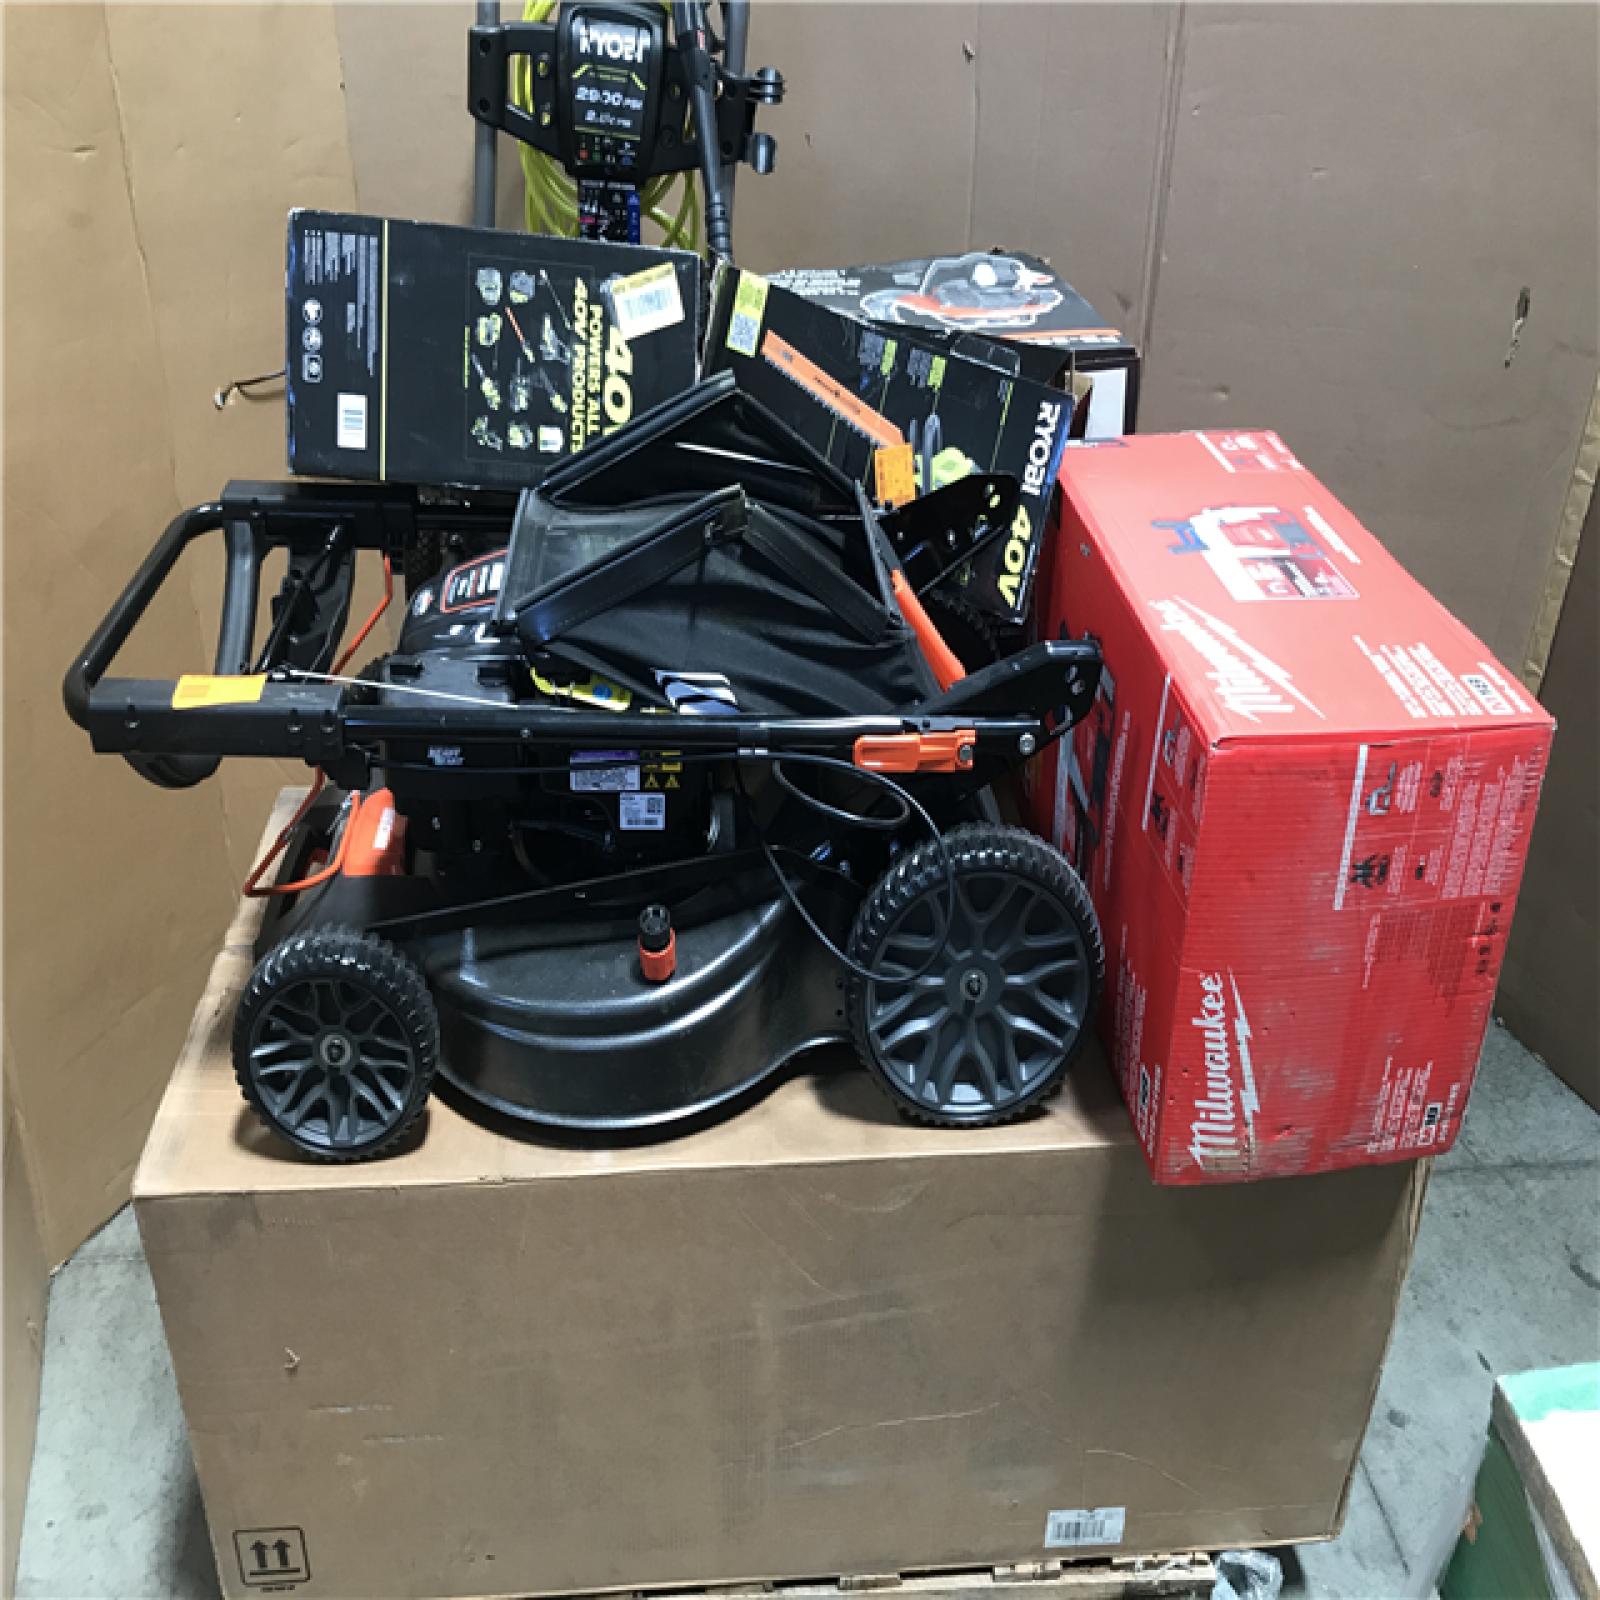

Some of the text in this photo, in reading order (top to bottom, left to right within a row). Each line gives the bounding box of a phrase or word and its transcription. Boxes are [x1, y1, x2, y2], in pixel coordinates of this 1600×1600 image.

[574, 276, 589, 341] 40V
[586, 304, 603, 436] POWERS ALL
[1020, 401, 1061, 496] RYOBI
[997, 504, 1031, 608] 40V
[1187, 971, 1241, 1168] Milwaukee
